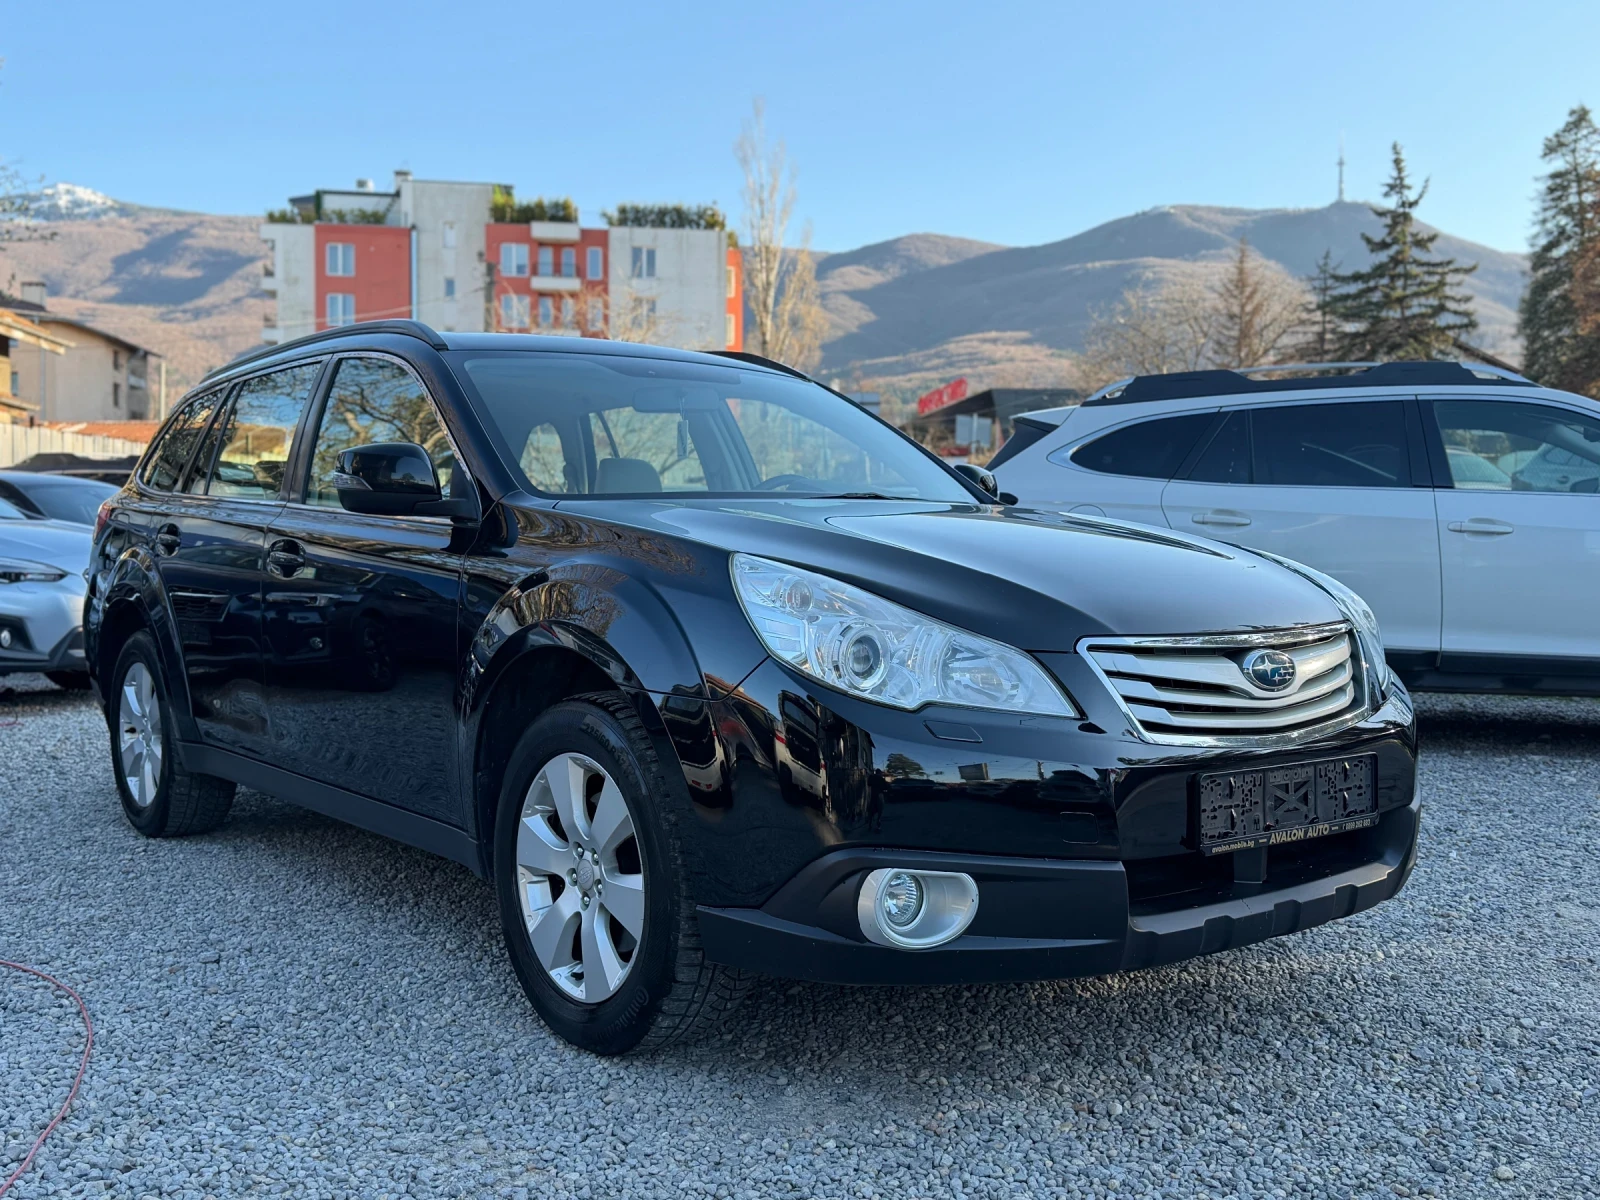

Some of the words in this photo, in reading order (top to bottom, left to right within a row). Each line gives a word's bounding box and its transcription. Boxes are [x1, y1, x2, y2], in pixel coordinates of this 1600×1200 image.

[1212, 840, 1255, 854] avalon.mobile.bg
[1269, 828, 1305, 845] AVALON
[1307, 824, 1330, 839] AUTO
